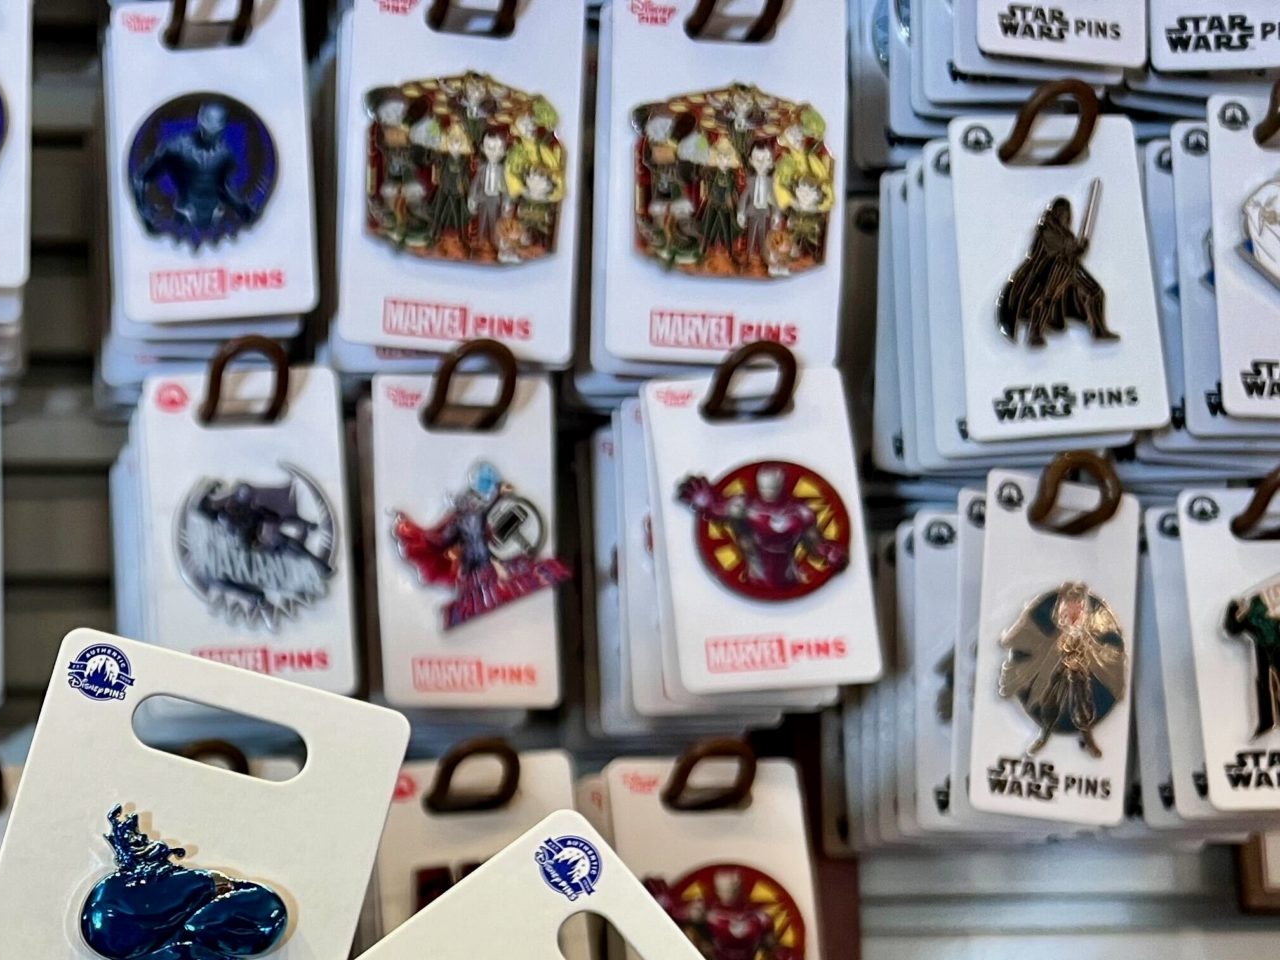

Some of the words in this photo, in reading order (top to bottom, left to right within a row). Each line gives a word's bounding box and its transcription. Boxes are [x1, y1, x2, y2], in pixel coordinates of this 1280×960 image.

[998, 4, 1066, 26] STAR
[1165, 15, 1255, 34] STAR
[999, 21, 1070, 42] WARS
[1073, 17, 1121, 40] PINS
[1167, 33, 1255, 54] WARS
[150, 267, 228, 303] MARVEL
[229, 270, 287, 290] PINS
[383, 297, 470, 341] MARVEL
[473, 316, 533, 340] PINS
[649, 309, 734, 350] MARVEL
[738, 323, 798, 346] PINS
[1240, 360, 1280, 379] ST
[993, 384, 1074, 407] STAR
[995, 402, 1076, 423] WARS
[1082, 386, 1138, 408] PINS
[85, 648, 126, 668] AUTHENTIC
[273, 650, 330, 670] PINS
[706, 635, 789, 673] MARVEL
[790, 638, 847, 659] PINS
[411, 657, 485, 692] MARVEL
[487, 664, 537, 686] PINS
[104, 688, 125, 700] PINS
[987, 758, 1057, 781] STAR
[1224, 751, 1280, 770] STA
[988, 777, 1059, 801] WARS
[1064, 775, 1113, 799] PINS
[1226, 769, 1280, 790] WA
[566, 840, 597, 875] AUTHENTIC
